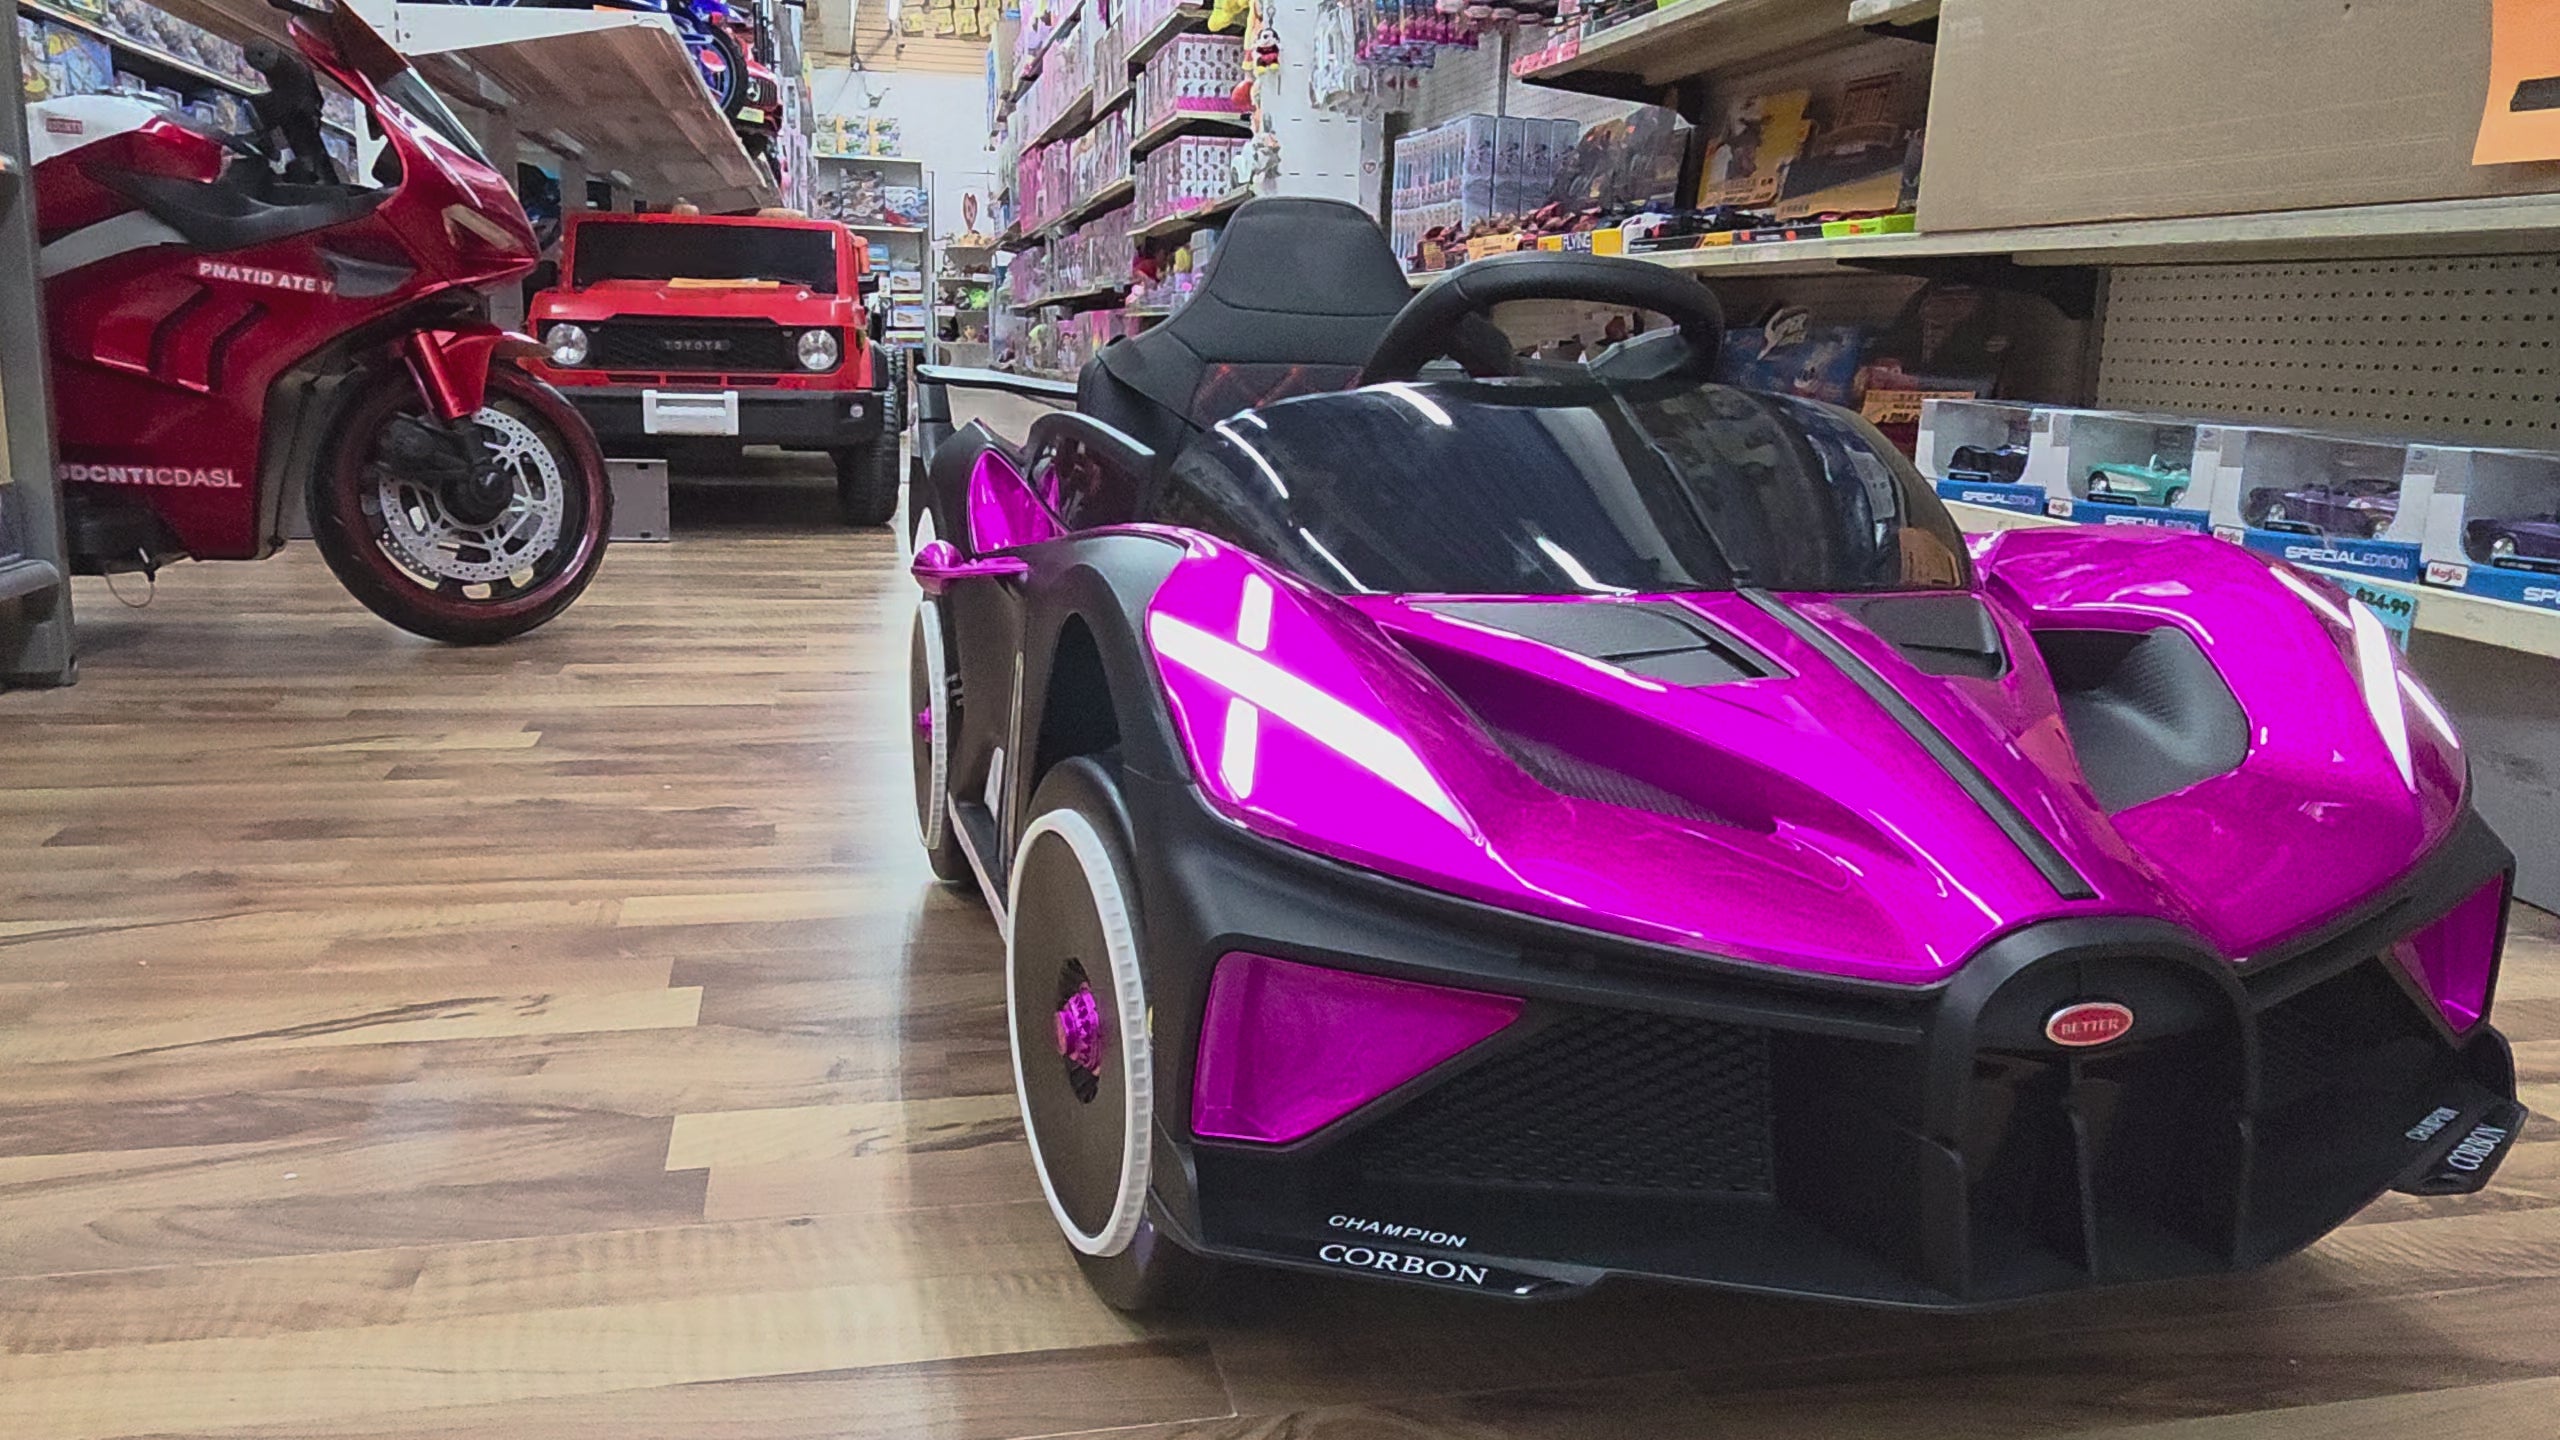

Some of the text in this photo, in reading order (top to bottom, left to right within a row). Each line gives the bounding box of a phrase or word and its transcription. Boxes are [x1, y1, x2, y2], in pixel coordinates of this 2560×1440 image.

[199, 262, 274, 285] PNATID
[277, 274, 316, 292] ATE
[2285, 546, 2408, 569] SPECIAL EDITION
[2523, 586, 2560, 604] SP
[2447, 1123, 2508, 1170] CORBON
[1328, 1214, 1467, 1247] CHAMPION
[1318, 1243, 1489, 1285] CORBON
